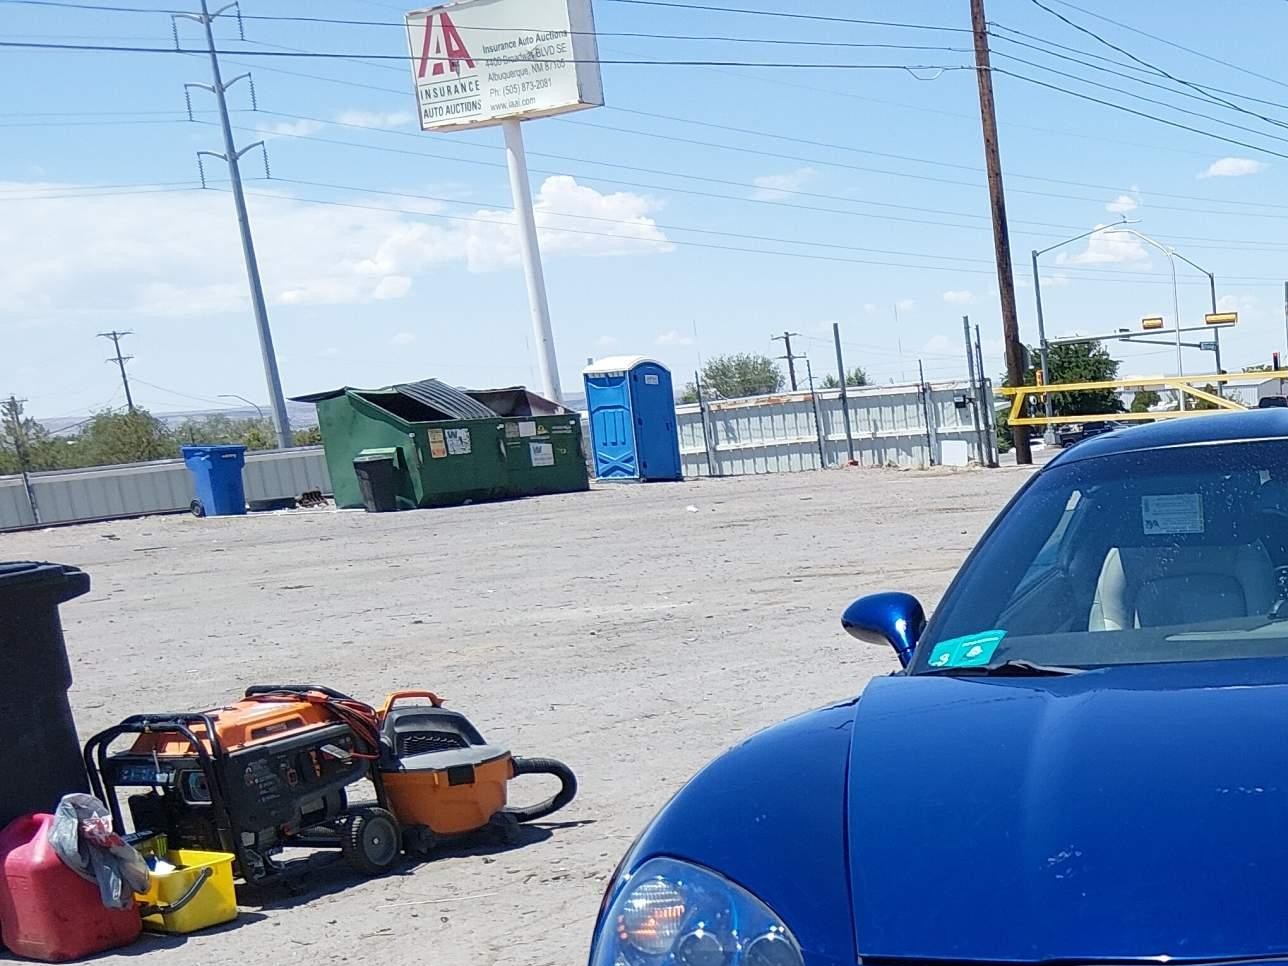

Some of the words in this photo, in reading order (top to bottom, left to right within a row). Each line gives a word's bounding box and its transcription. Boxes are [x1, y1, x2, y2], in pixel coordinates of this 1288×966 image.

[482, 41, 517, 54] Insurance
[518, 36, 534, 46] Auto
[535, 30, 568, 43] Auctions
[535, 45, 556, 57] BLVD
[556, 42, 568, 53] SE
[531, 62, 544, 73] NM
[420, 80, 480, 100] INSURANCE
[502, 82, 521, 97] (505)
[521, 77, 552, 92] 873-2081
[423, 106, 444, 119] AUTO
[445, 100, 482, 115] AUCTIONS
